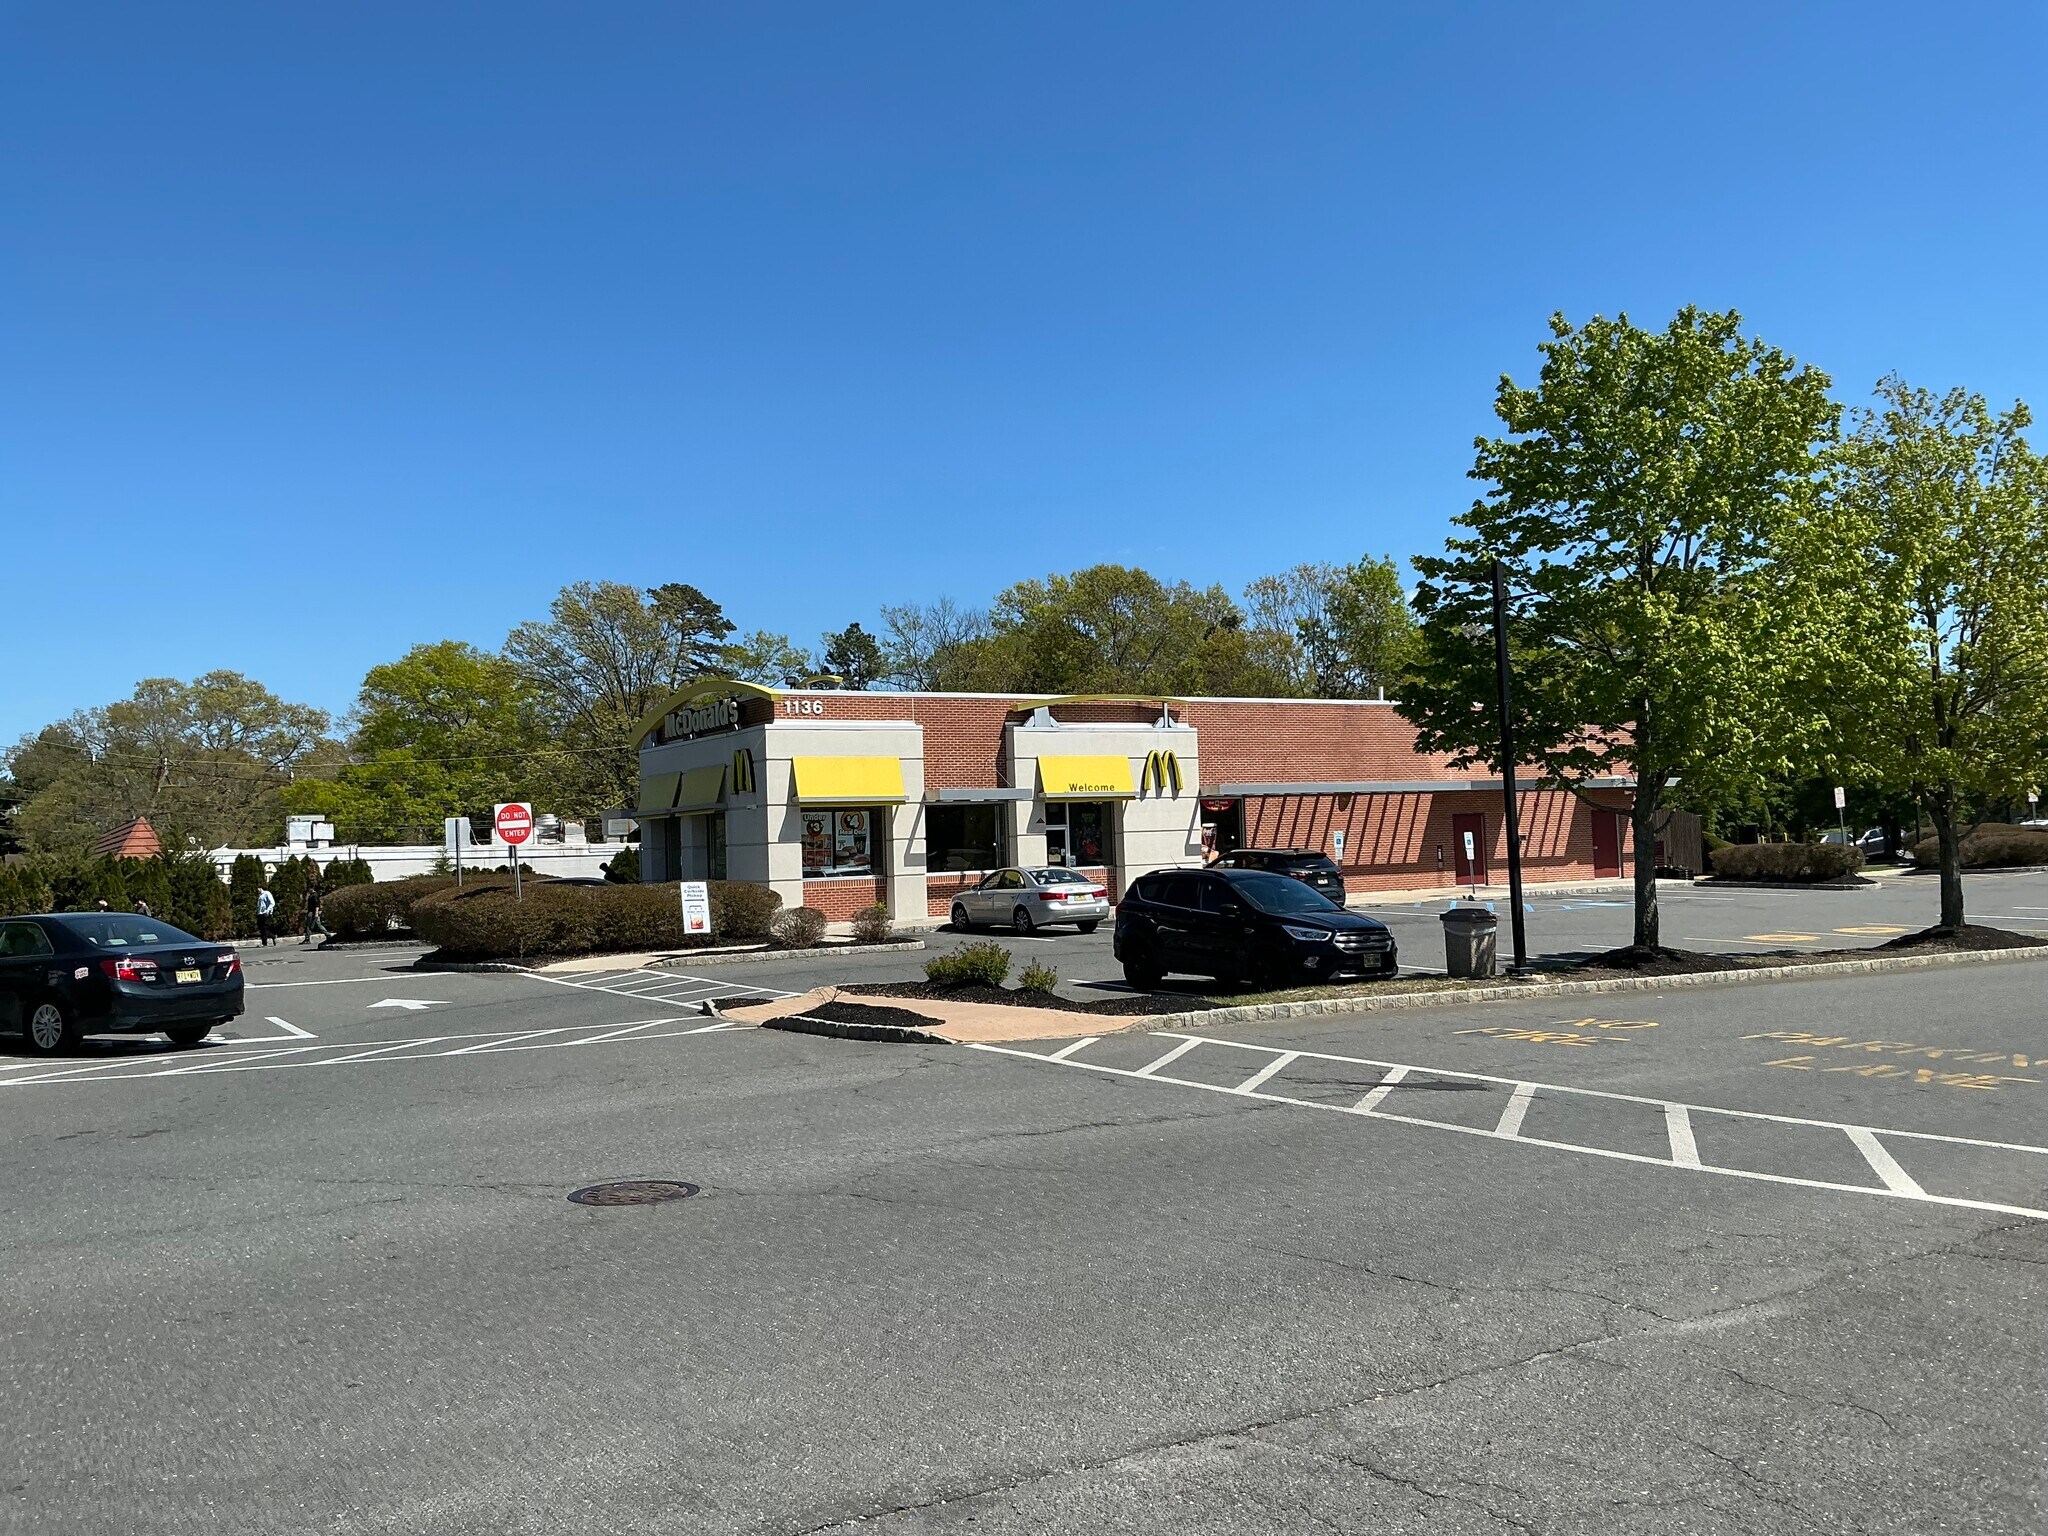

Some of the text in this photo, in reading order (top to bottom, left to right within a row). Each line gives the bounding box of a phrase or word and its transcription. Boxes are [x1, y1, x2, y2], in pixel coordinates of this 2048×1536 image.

[784, 700, 823, 715] 1136
[664, 698, 739, 737] McDonald's
[1068, 783, 1115, 792] Welcome
